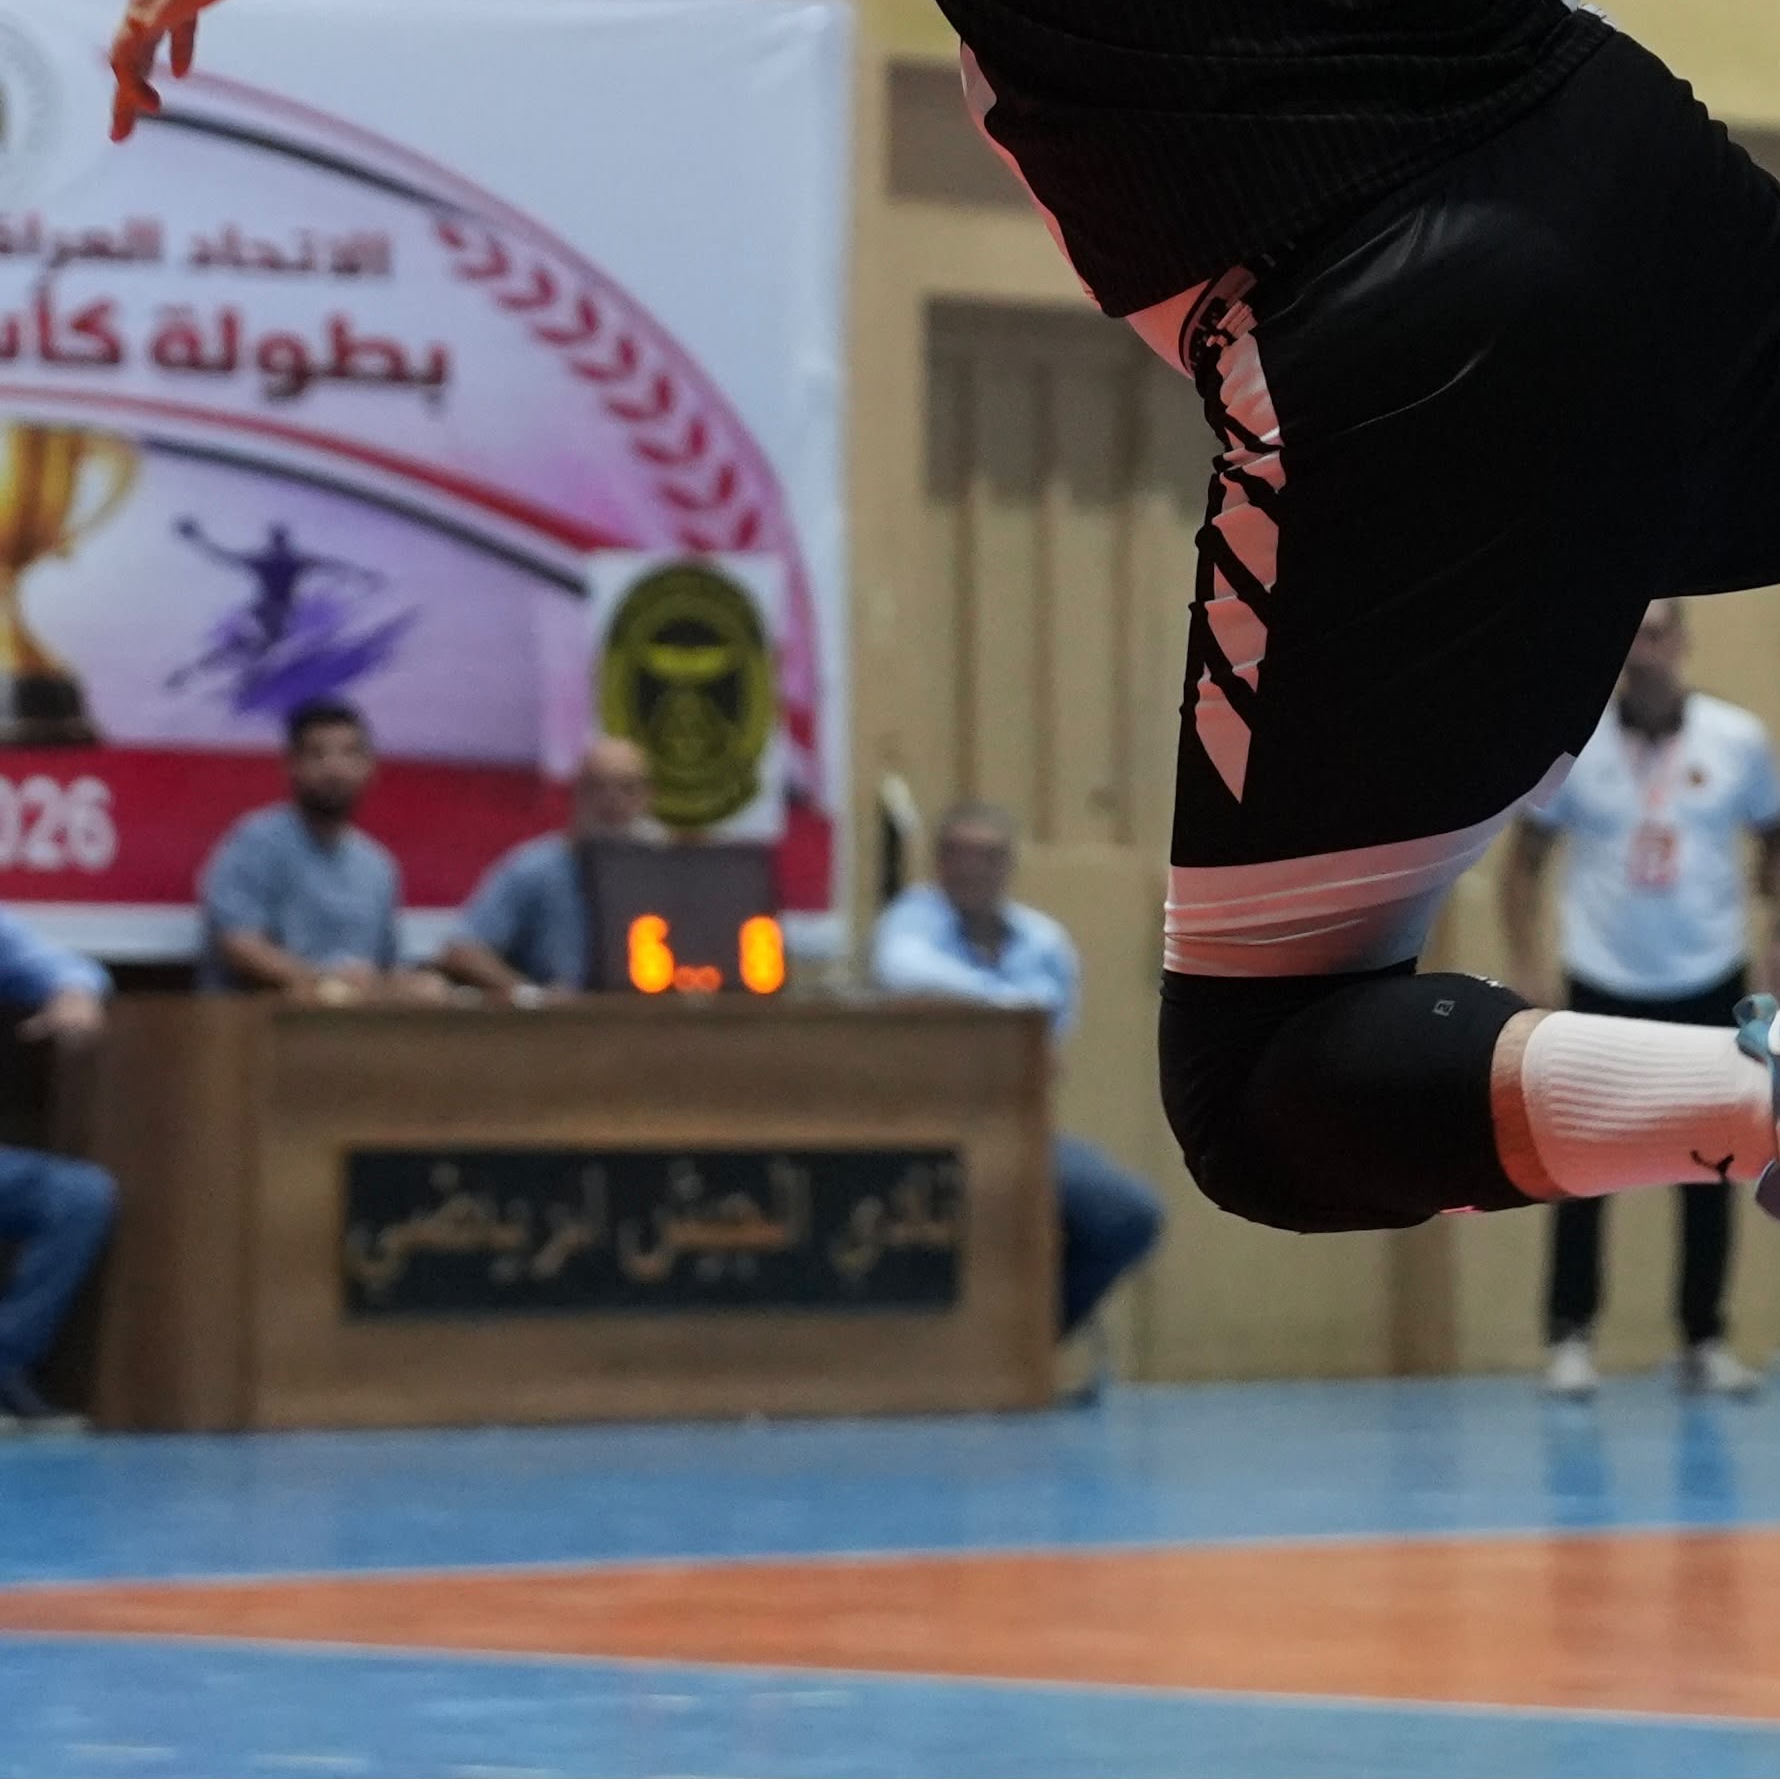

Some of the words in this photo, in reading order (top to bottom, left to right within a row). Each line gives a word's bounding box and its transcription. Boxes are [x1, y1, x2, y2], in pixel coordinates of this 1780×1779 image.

[150, 302, 451, 412] بطولة
[0, 773, 120, 874] 26
[628, 913, 676, 994] 6
